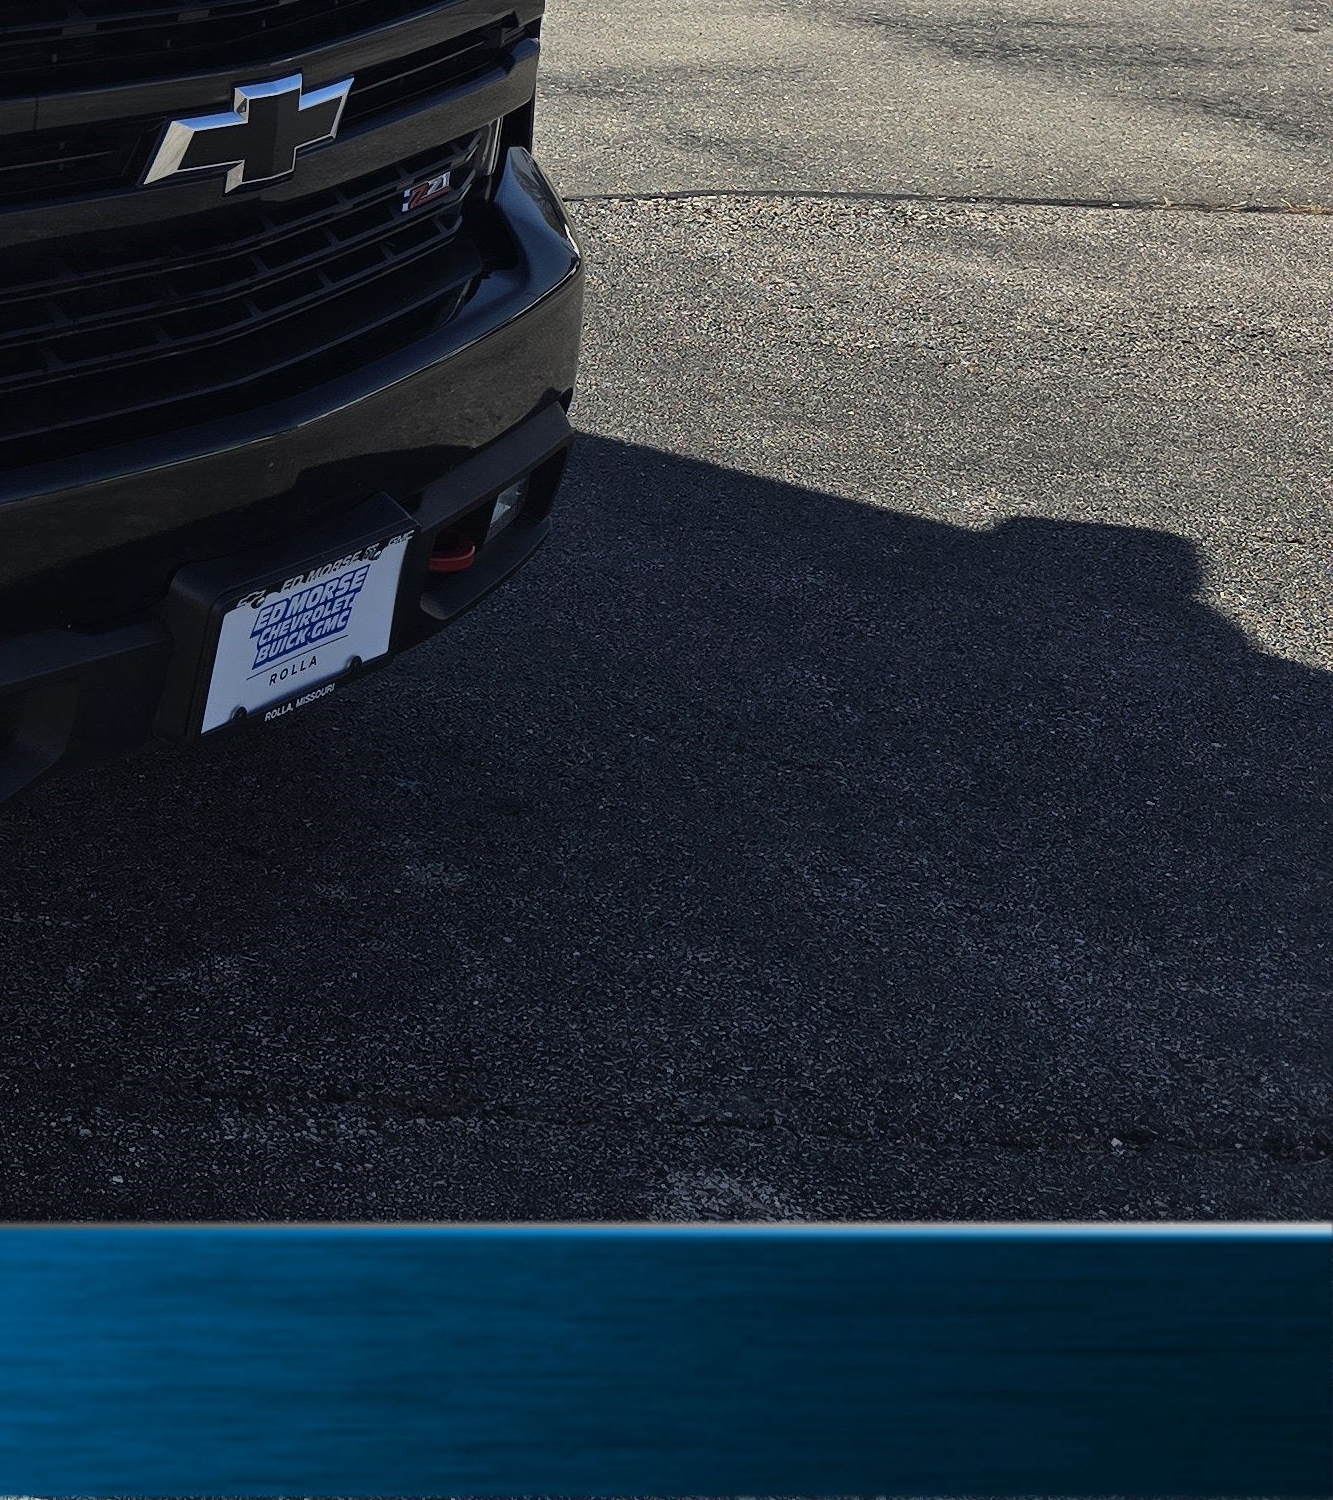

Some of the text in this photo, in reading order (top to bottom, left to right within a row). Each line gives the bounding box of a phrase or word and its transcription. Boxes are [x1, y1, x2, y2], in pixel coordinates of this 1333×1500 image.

[401, 171, 452, 212] Z71
[255, 569, 367, 630] ED MORSE
[259, 595, 353, 648] CHEVROLET
[269, 655, 318, 686] ROLLA
[296, 683, 336, 708] MISSOURI
